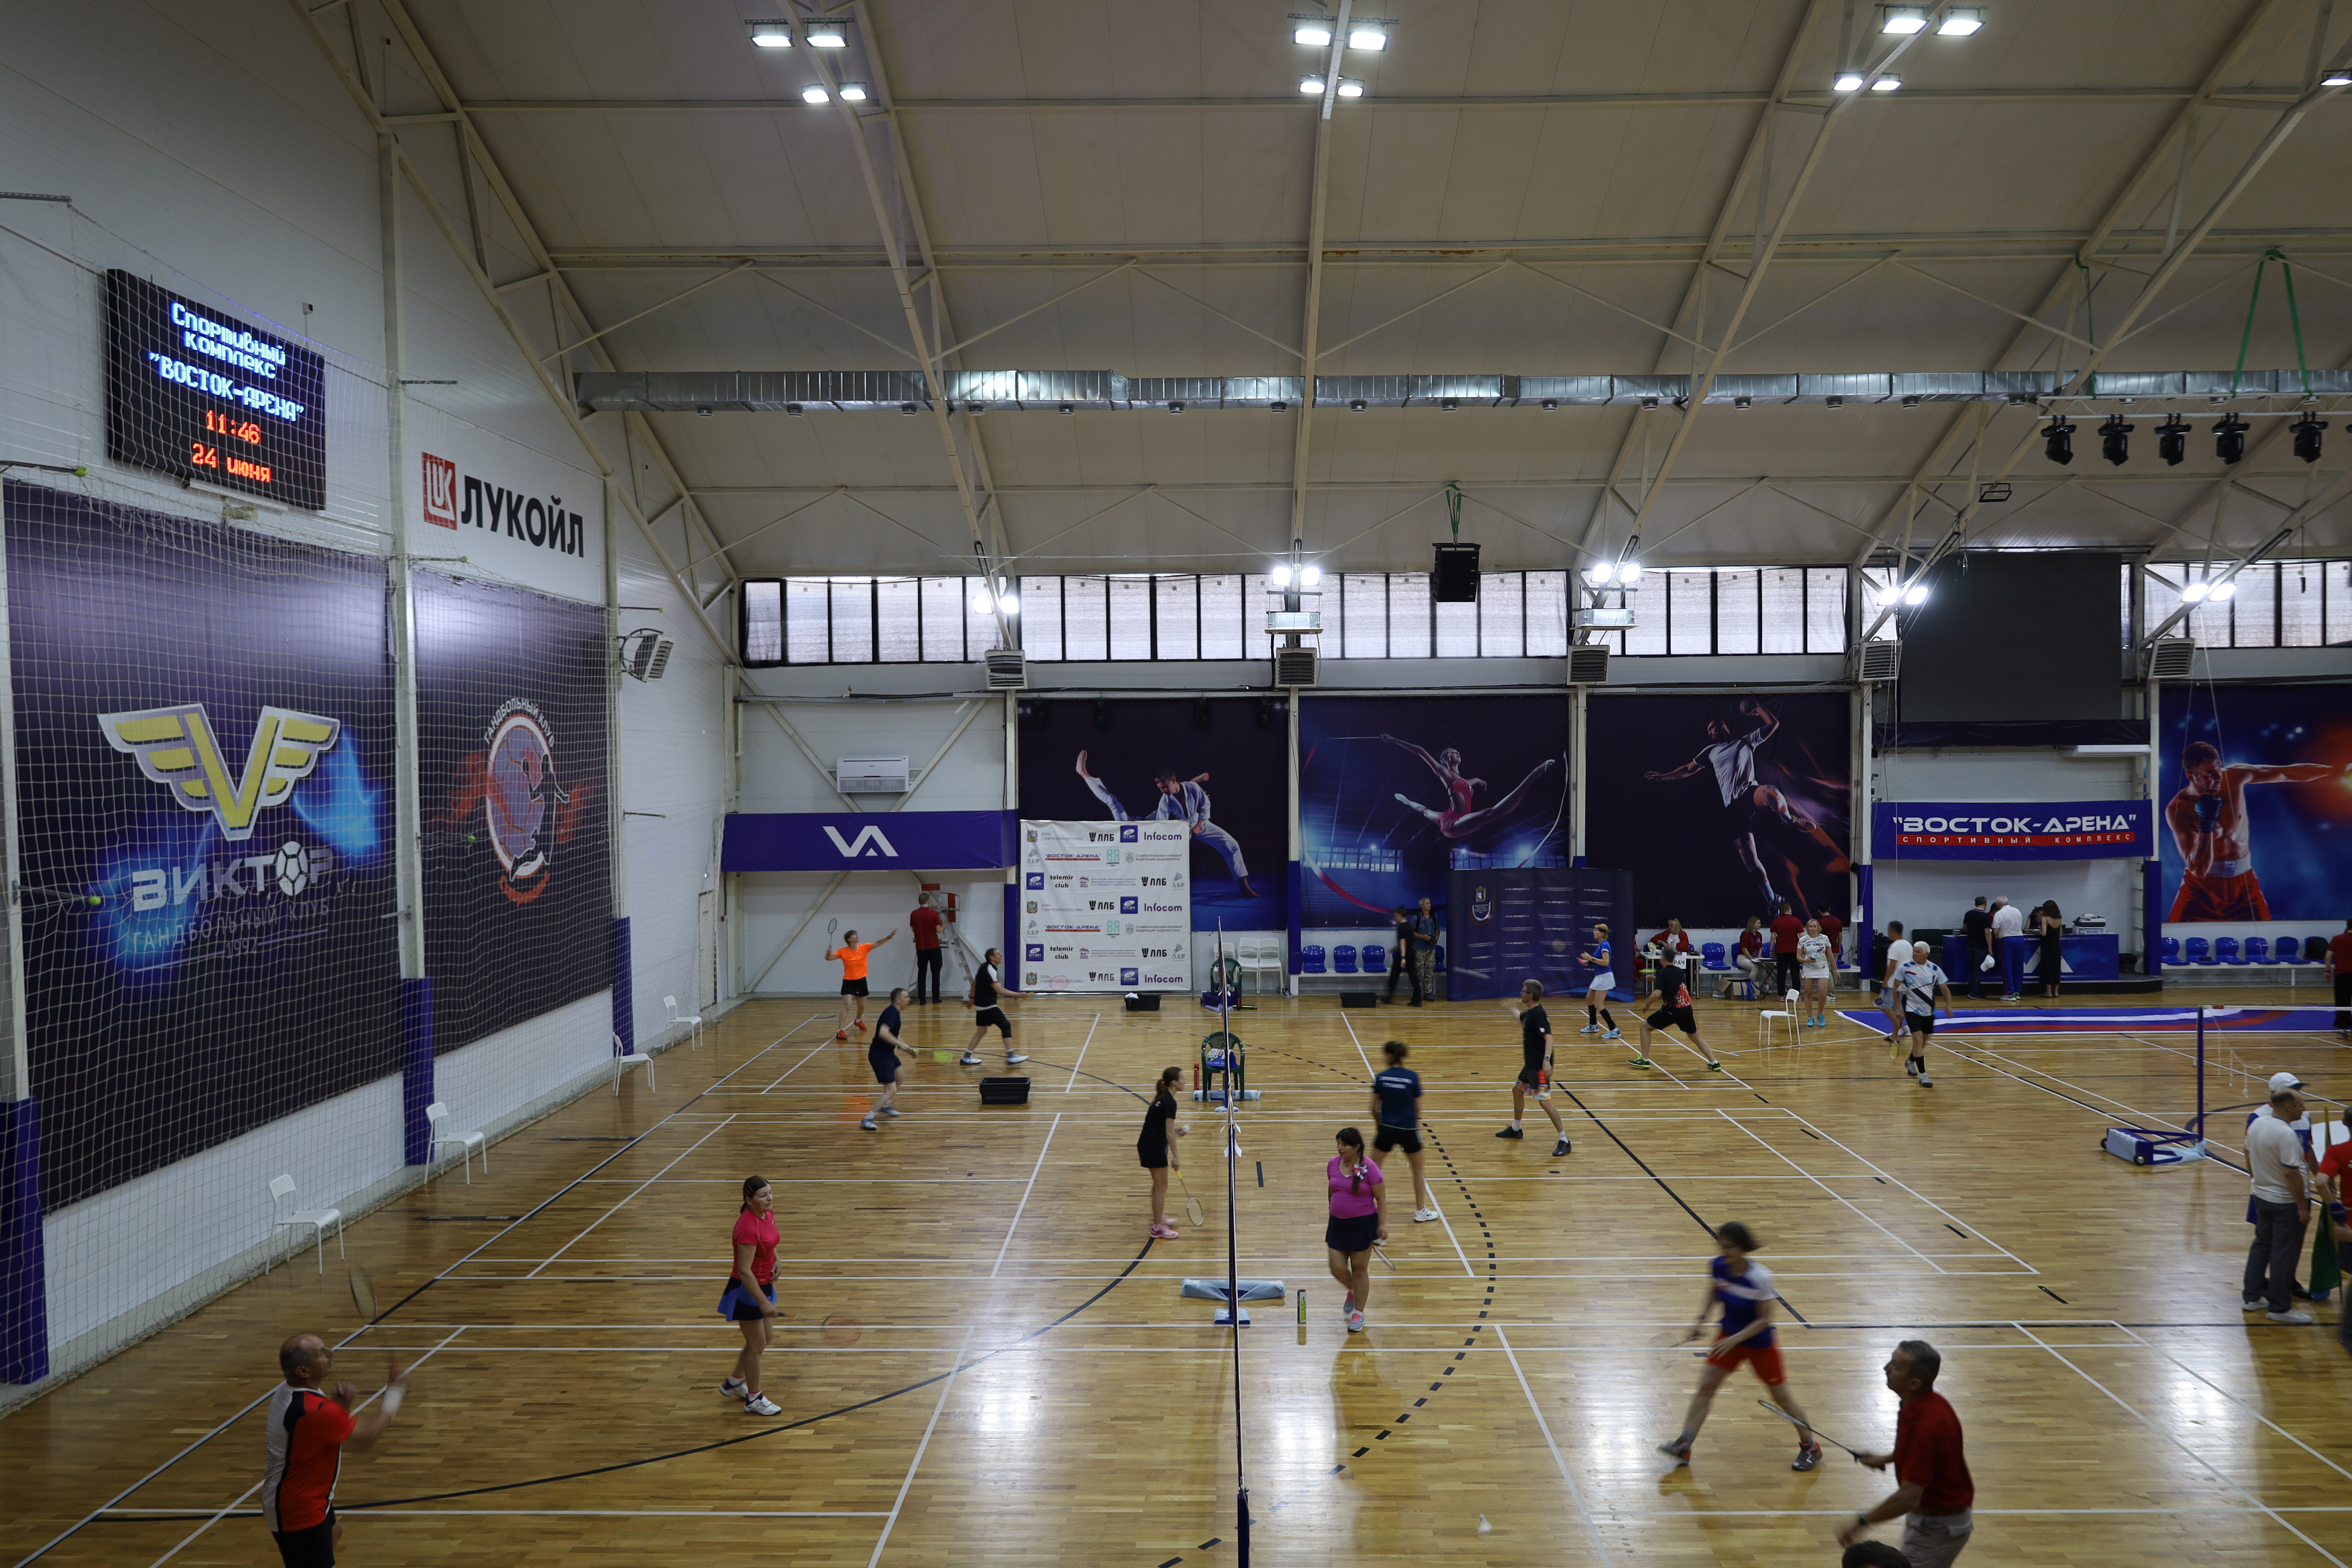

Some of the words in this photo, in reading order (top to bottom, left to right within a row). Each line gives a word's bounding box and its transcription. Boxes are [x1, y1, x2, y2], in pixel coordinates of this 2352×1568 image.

[171, 302, 286, 366] Спортивный
[207, 410, 261, 444] 11:46
[192, 443, 217, 468] 24
[227, 457, 271, 482] июня
[461, 475, 584, 558] ЛУКОЙЛ
[484, 698, 539, 745] ГАНДБОЛЬНЫЙ
[539, 713, 555, 747] КЛУБ
[1144, 831, 1182, 840] Infocom
[1892, 814, 2137, 833] "ВОСТОК-АРЕНА"
[2055, 833, 2130, 844] КОМПЛЕКС
[1144, 903, 1182, 911] Infocom
[134, 905, 277, 953] ГАНДБОЛЬНЫЙ
[289, 899, 329, 921] КЛУБ
[226, 937, 257, 959] 1992
[1145, 974, 1183, 983] Infocom
